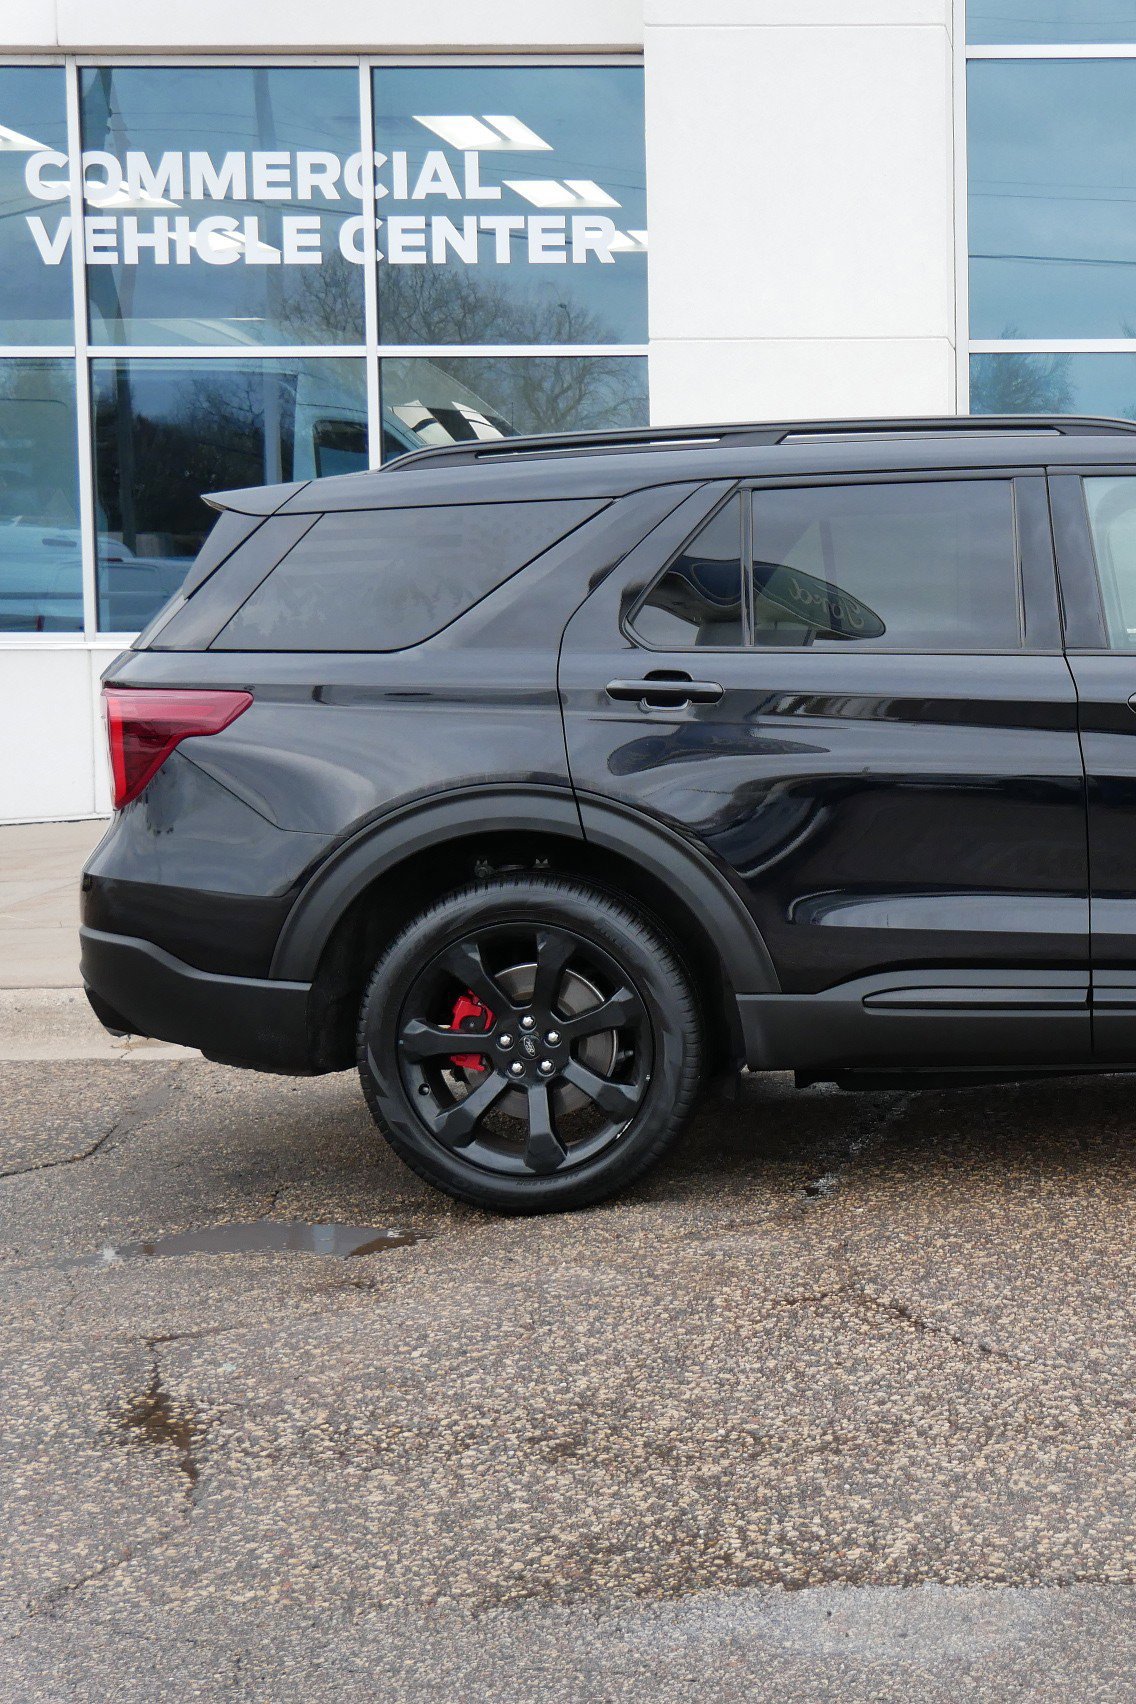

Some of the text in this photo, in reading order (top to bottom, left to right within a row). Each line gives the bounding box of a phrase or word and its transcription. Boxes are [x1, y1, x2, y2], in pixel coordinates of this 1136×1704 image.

[24, 150, 502, 201] COMMERCIAL
[26, 215, 616, 266] VEHICLE CENTER
